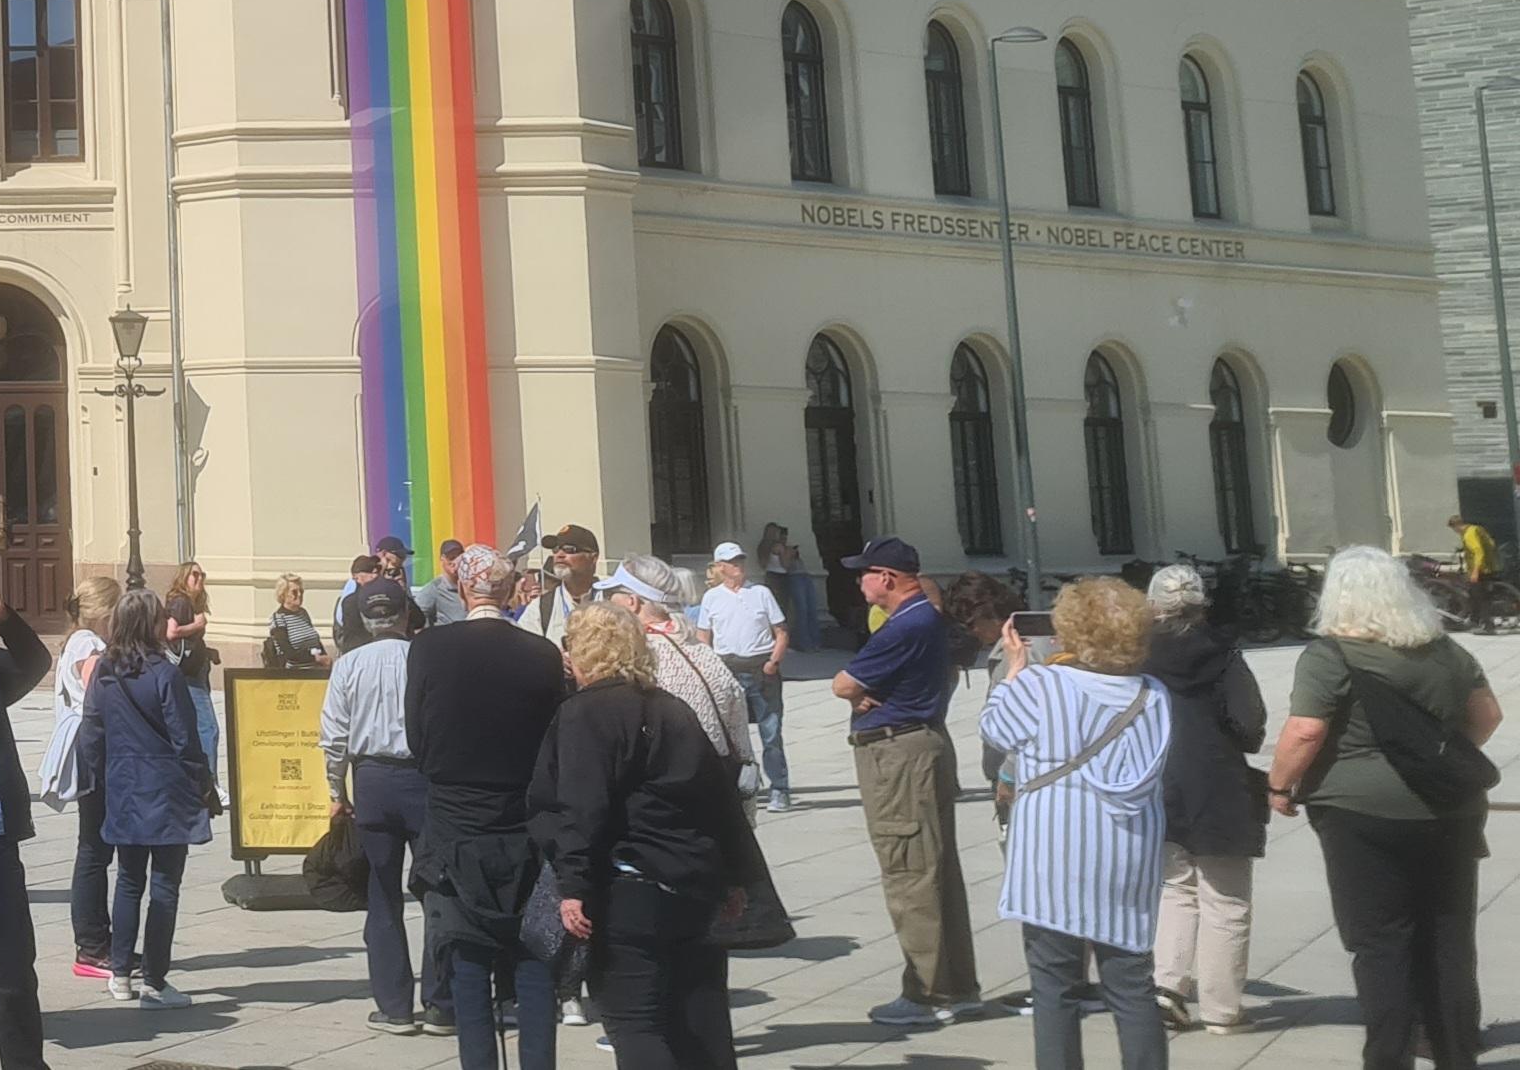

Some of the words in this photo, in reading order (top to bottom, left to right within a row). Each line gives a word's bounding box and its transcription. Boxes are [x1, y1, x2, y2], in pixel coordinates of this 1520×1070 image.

[800, 203, 885, 231] NOBELS
[1047, 226, 1111, 249] NOBEL
[1114, 231, 1173, 254] PEACE
[1177, 237, 1246, 259] CENTER
